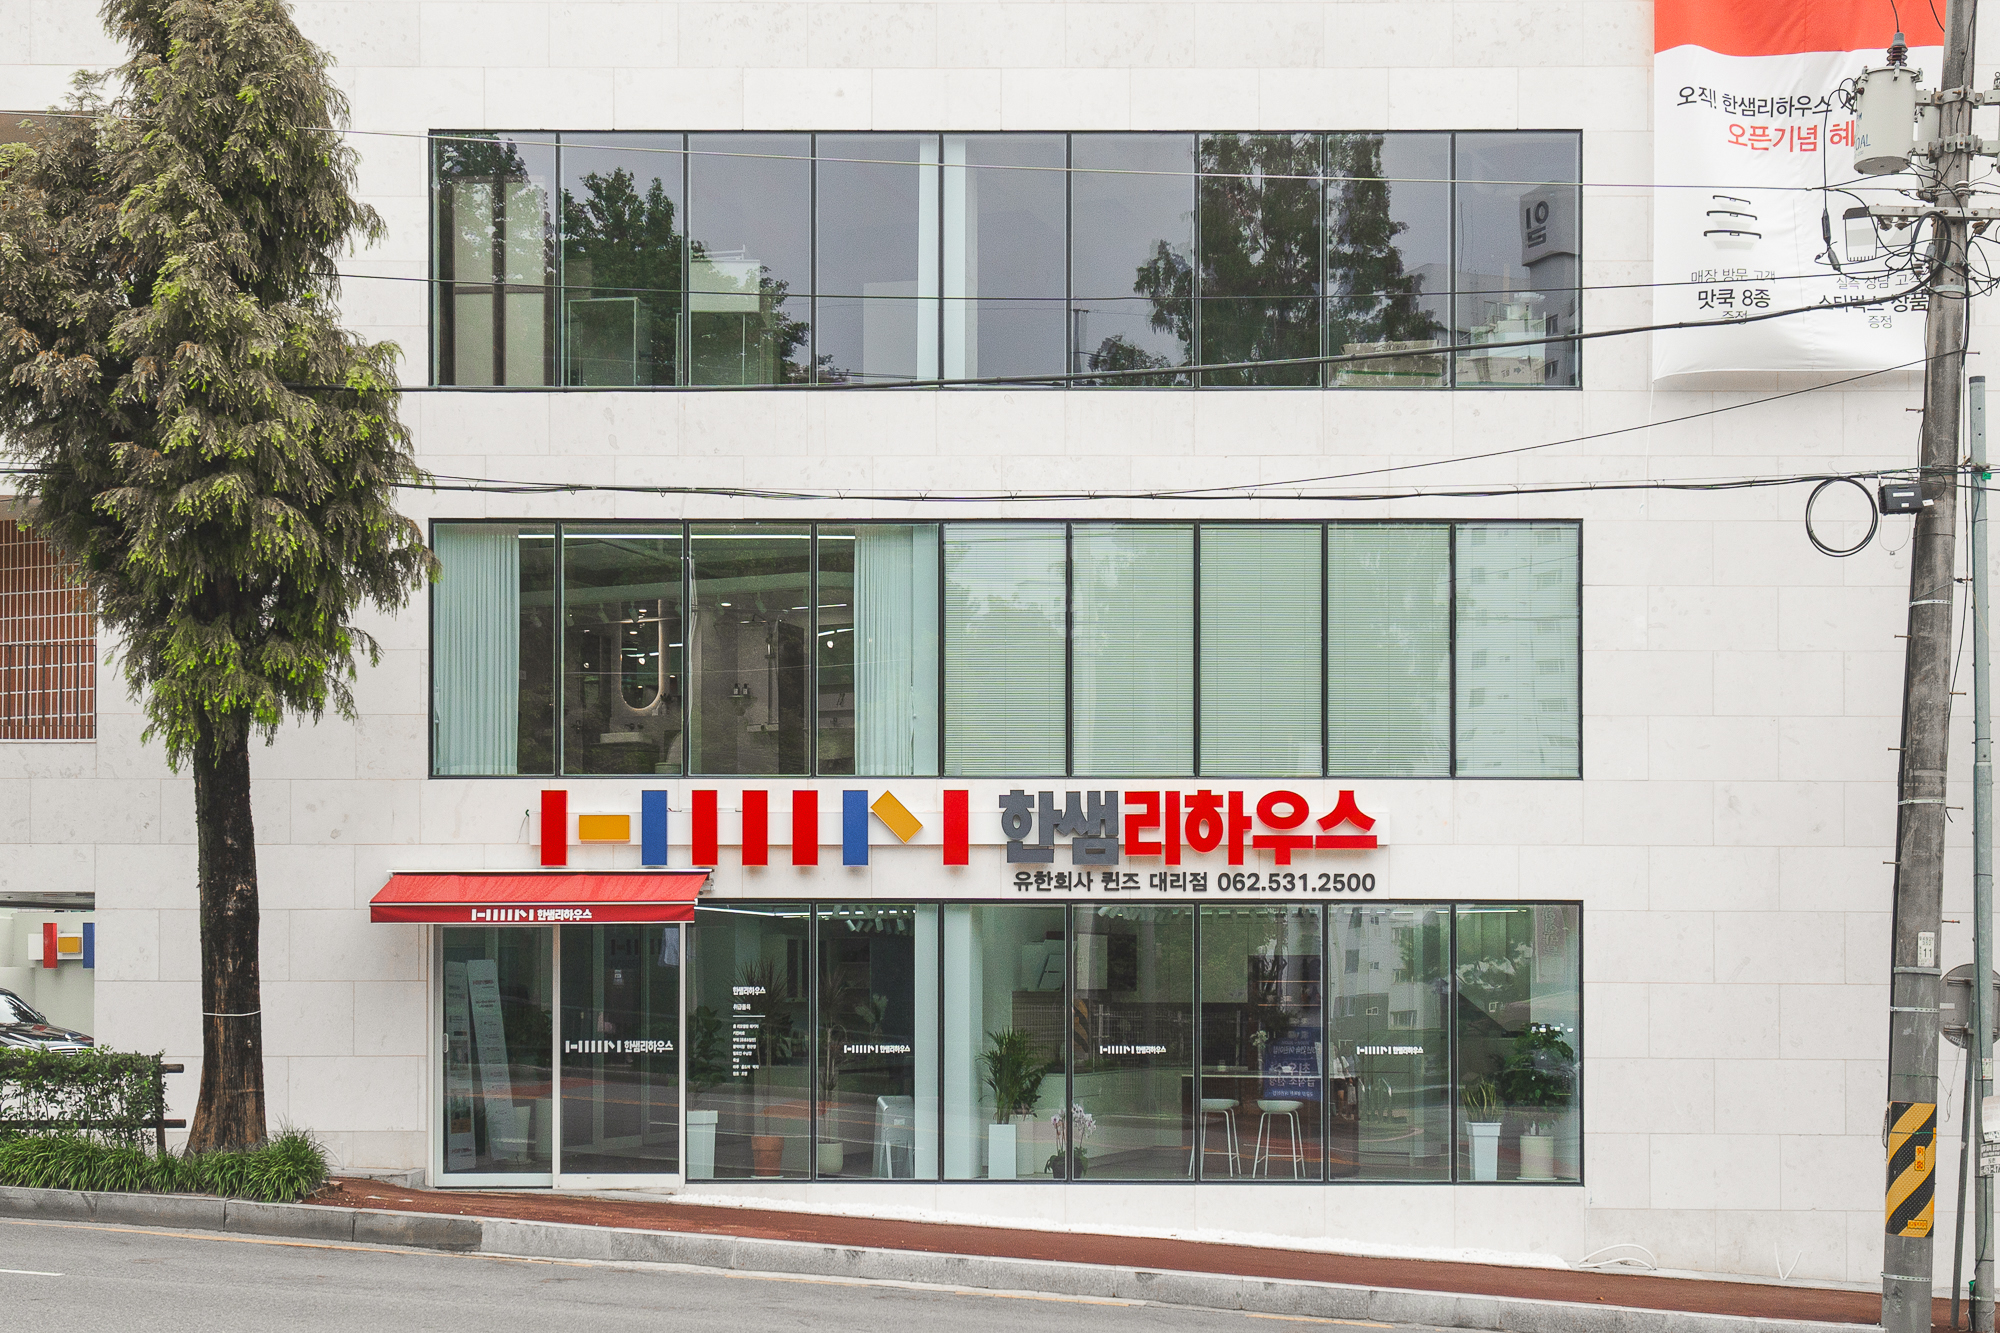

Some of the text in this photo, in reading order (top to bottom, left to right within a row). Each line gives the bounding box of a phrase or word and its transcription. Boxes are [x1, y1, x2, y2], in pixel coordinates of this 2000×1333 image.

[1677, 86, 1833, 118] 오직! 한샘리하우스
[1727, 123, 1819, 152] 오픈기념
[1691, 269, 1718, 283] 매장
[1723, 268, 1749, 282] 방문
[1698, 288, 1771, 310] 맛쿡 8종
[1868, 315, 1893, 329] 증정
[999, 789, 1378, 866] 한샘리하우스
[1013, 870, 1376, 892] 유한회사 퀸즈 대리점 062.531.2500
[537, 908, 593, 921] 한샘리하우스
